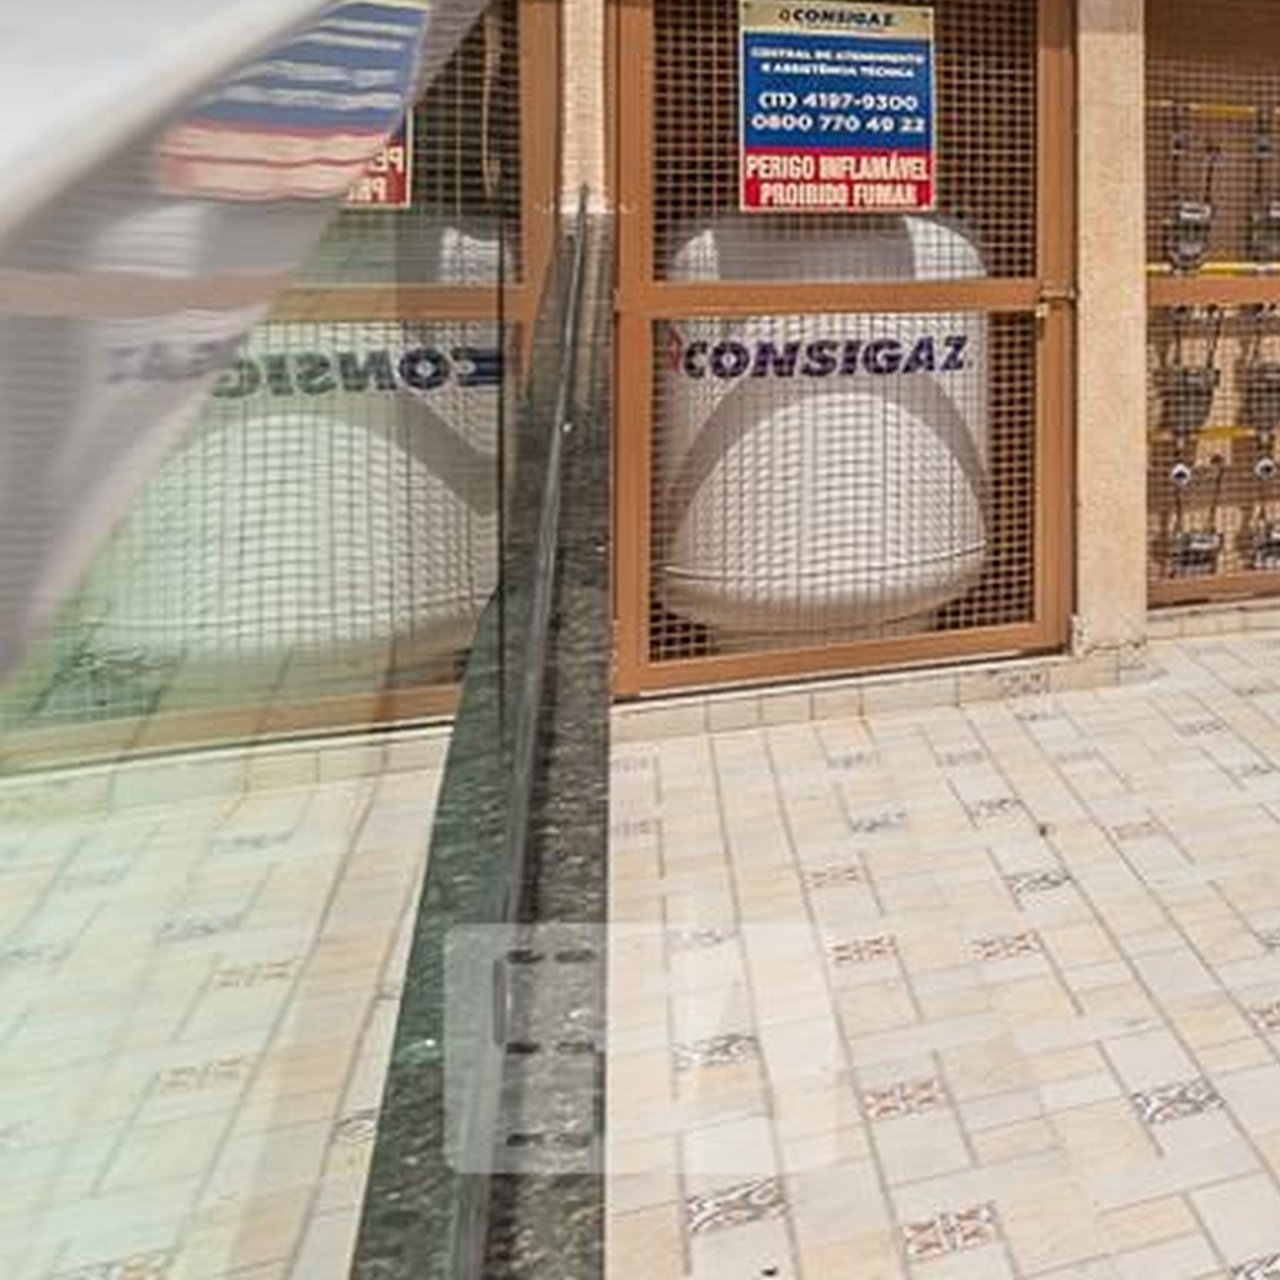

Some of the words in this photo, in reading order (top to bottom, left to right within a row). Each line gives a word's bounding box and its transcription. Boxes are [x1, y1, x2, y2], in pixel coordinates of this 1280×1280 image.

[792, 8, 893, 27] CONSIGAZ
[758, 92, 797, 110] (11)
[801, 93, 919, 112] 4197-9300
[751, 114, 814, 132] 0800
[818, 115, 861, 132] 770
[900, 117, 926, 133] 22
[746, 153, 815, 181] PERIGO
[818, 150, 929, 182] INFLAMÁVEL
[759, 181, 850, 205] PROIBIDO
[852, 183, 919, 205] FUMAR
[683, 334, 968, 379] CONSIGAZ
